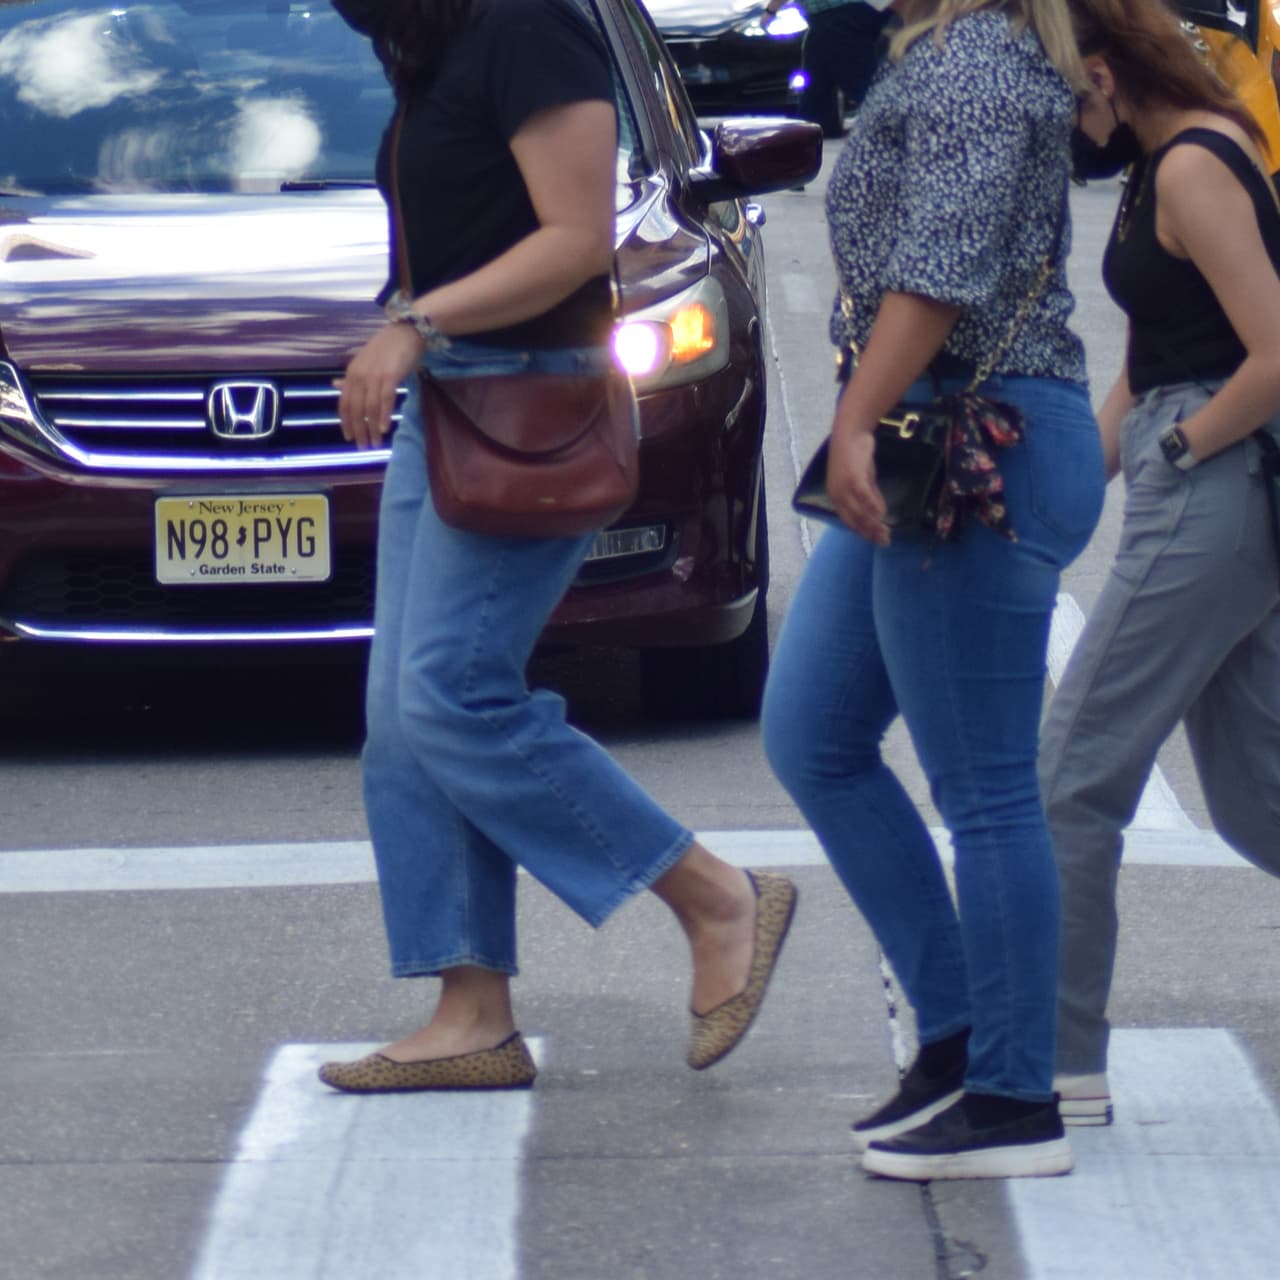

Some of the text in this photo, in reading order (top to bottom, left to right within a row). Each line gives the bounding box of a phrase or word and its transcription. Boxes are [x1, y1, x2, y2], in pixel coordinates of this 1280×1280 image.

[199, 500, 285, 517] New Jersey
[167, 516, 316, 561] N98 PYG
[199, 562, 286, 576] Garden State
